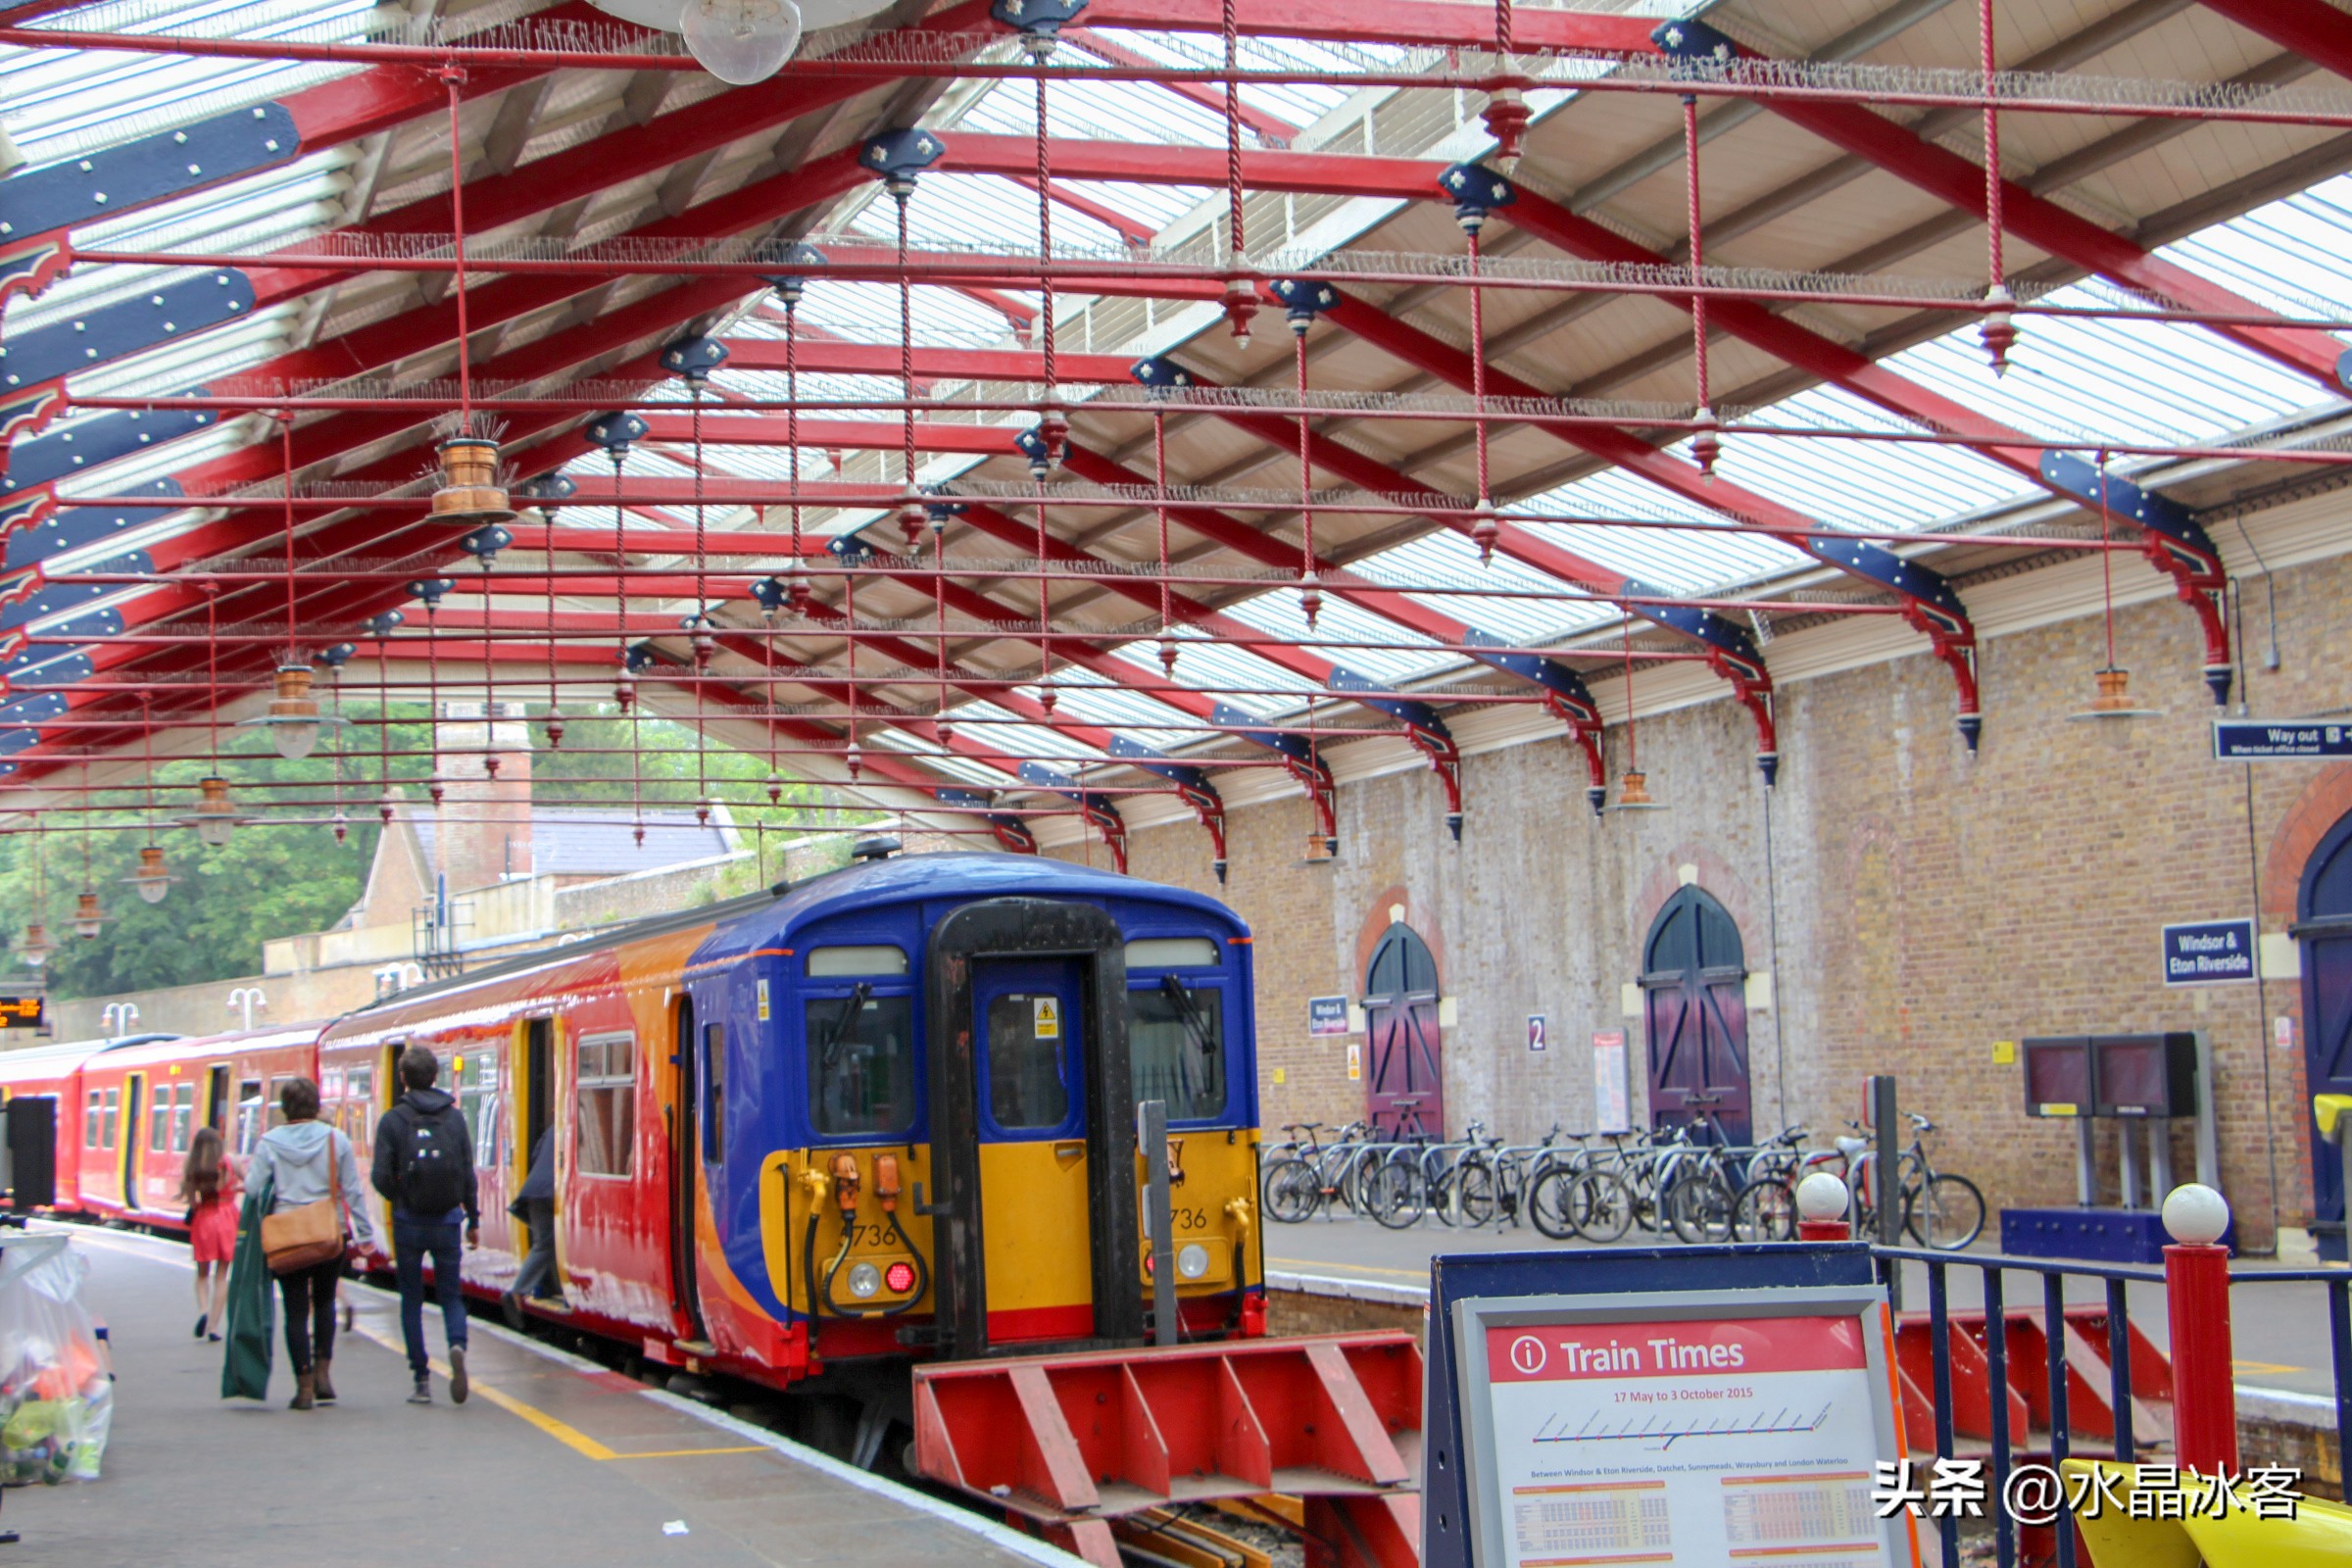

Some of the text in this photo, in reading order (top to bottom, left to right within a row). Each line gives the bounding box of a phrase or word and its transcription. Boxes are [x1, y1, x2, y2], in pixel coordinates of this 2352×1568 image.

[2267, 728, 2319, 745] Way out
[2178, 931, 2237, 953] Windsor &
[2169, 953, 2248, 975] Eton Riverside
[1532, 1019, 1544, 1049] 2
[1560, 1338, 1744, 1373] Train Times
[1614, 1387, 1753, 1403] 17 May to 3 October 2015
[1531, 1456, 1848, 1479] Between Windsor & Eton Riverside, Datchet, Sunnymeads, Wraysbury and London Waterloo
